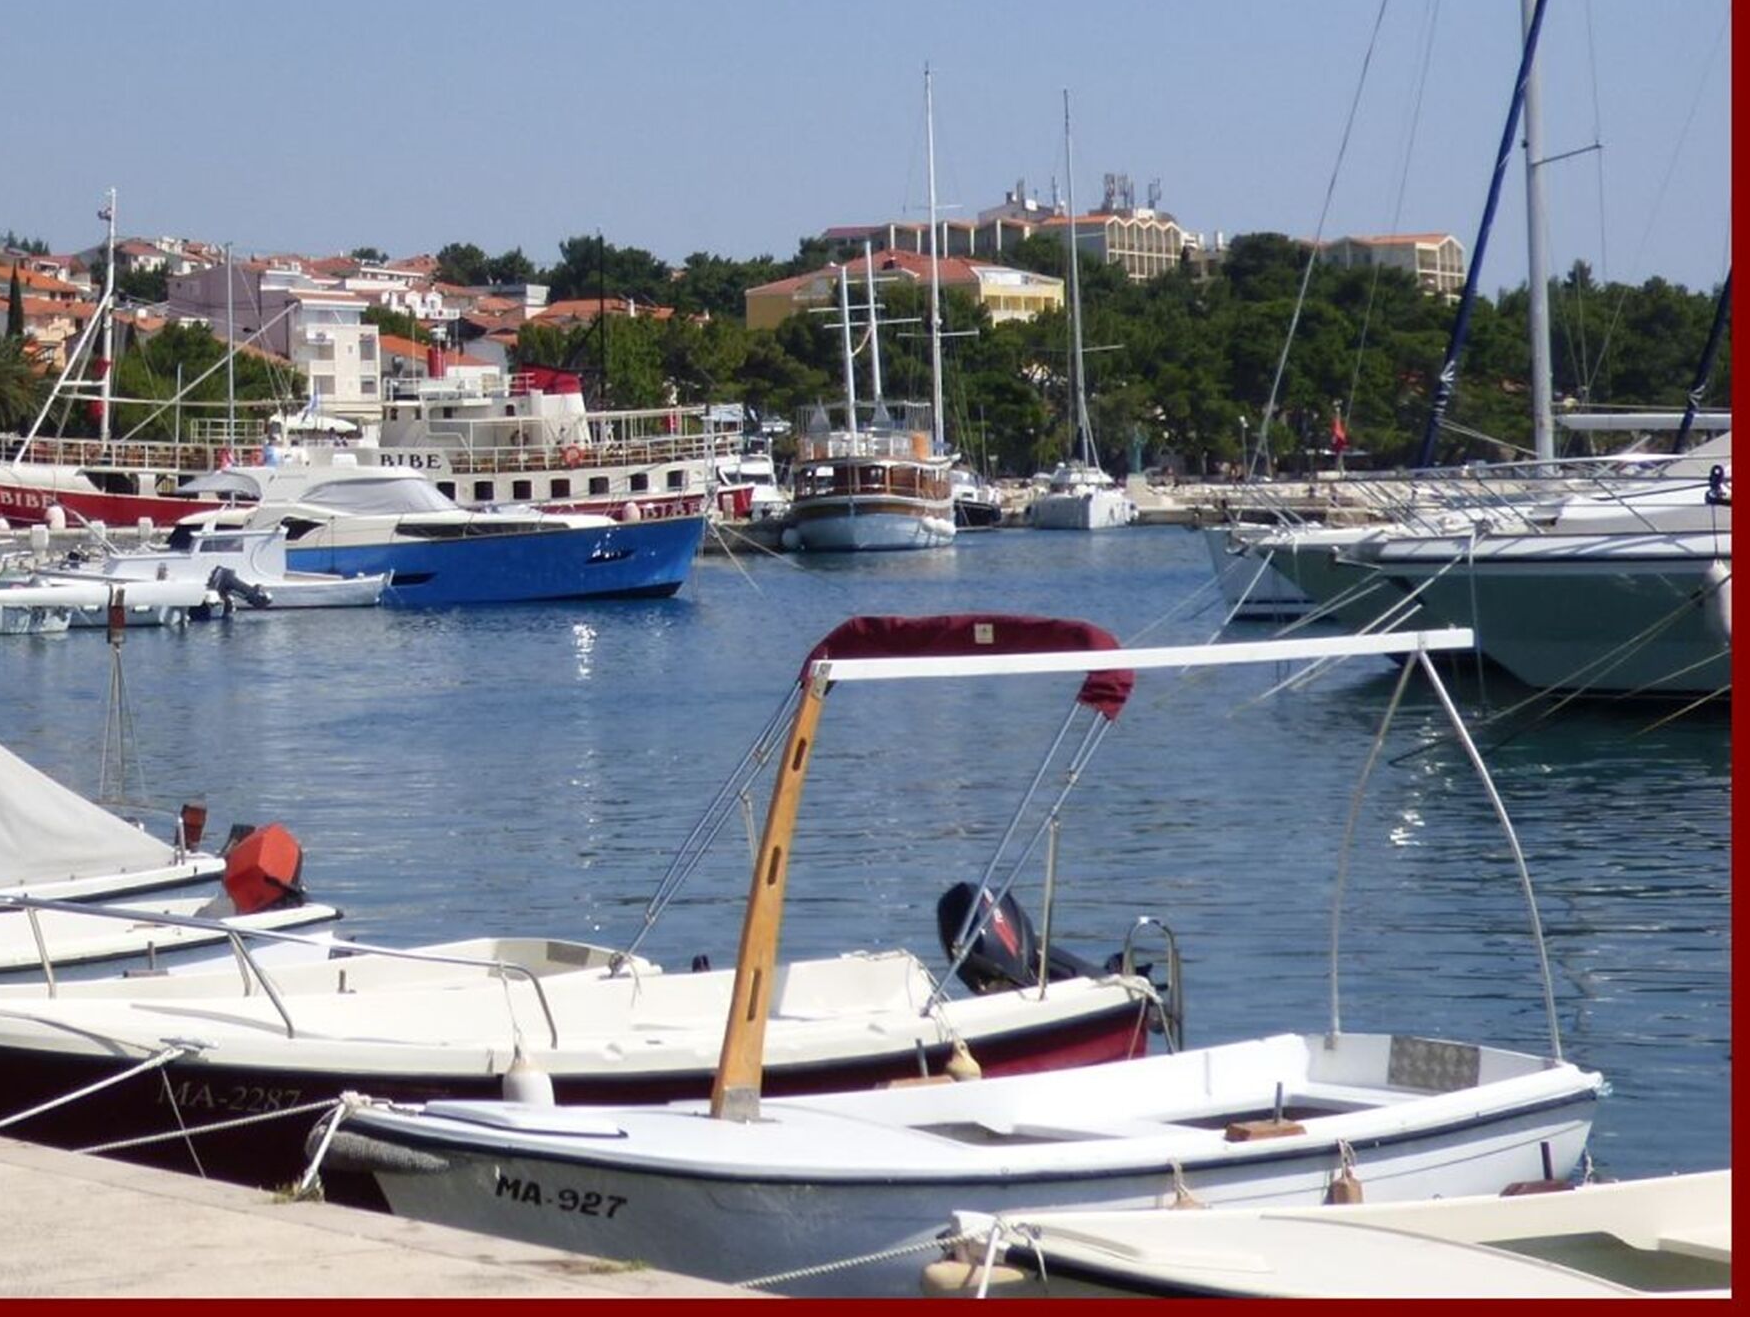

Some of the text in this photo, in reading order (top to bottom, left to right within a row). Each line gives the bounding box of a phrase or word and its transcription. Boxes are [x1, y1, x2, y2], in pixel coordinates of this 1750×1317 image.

[380, 454, 441, 470] BIBE
[158, 1081, 301, 1113] MA-2287
[496, 1175, 627, 1219] MA-927
